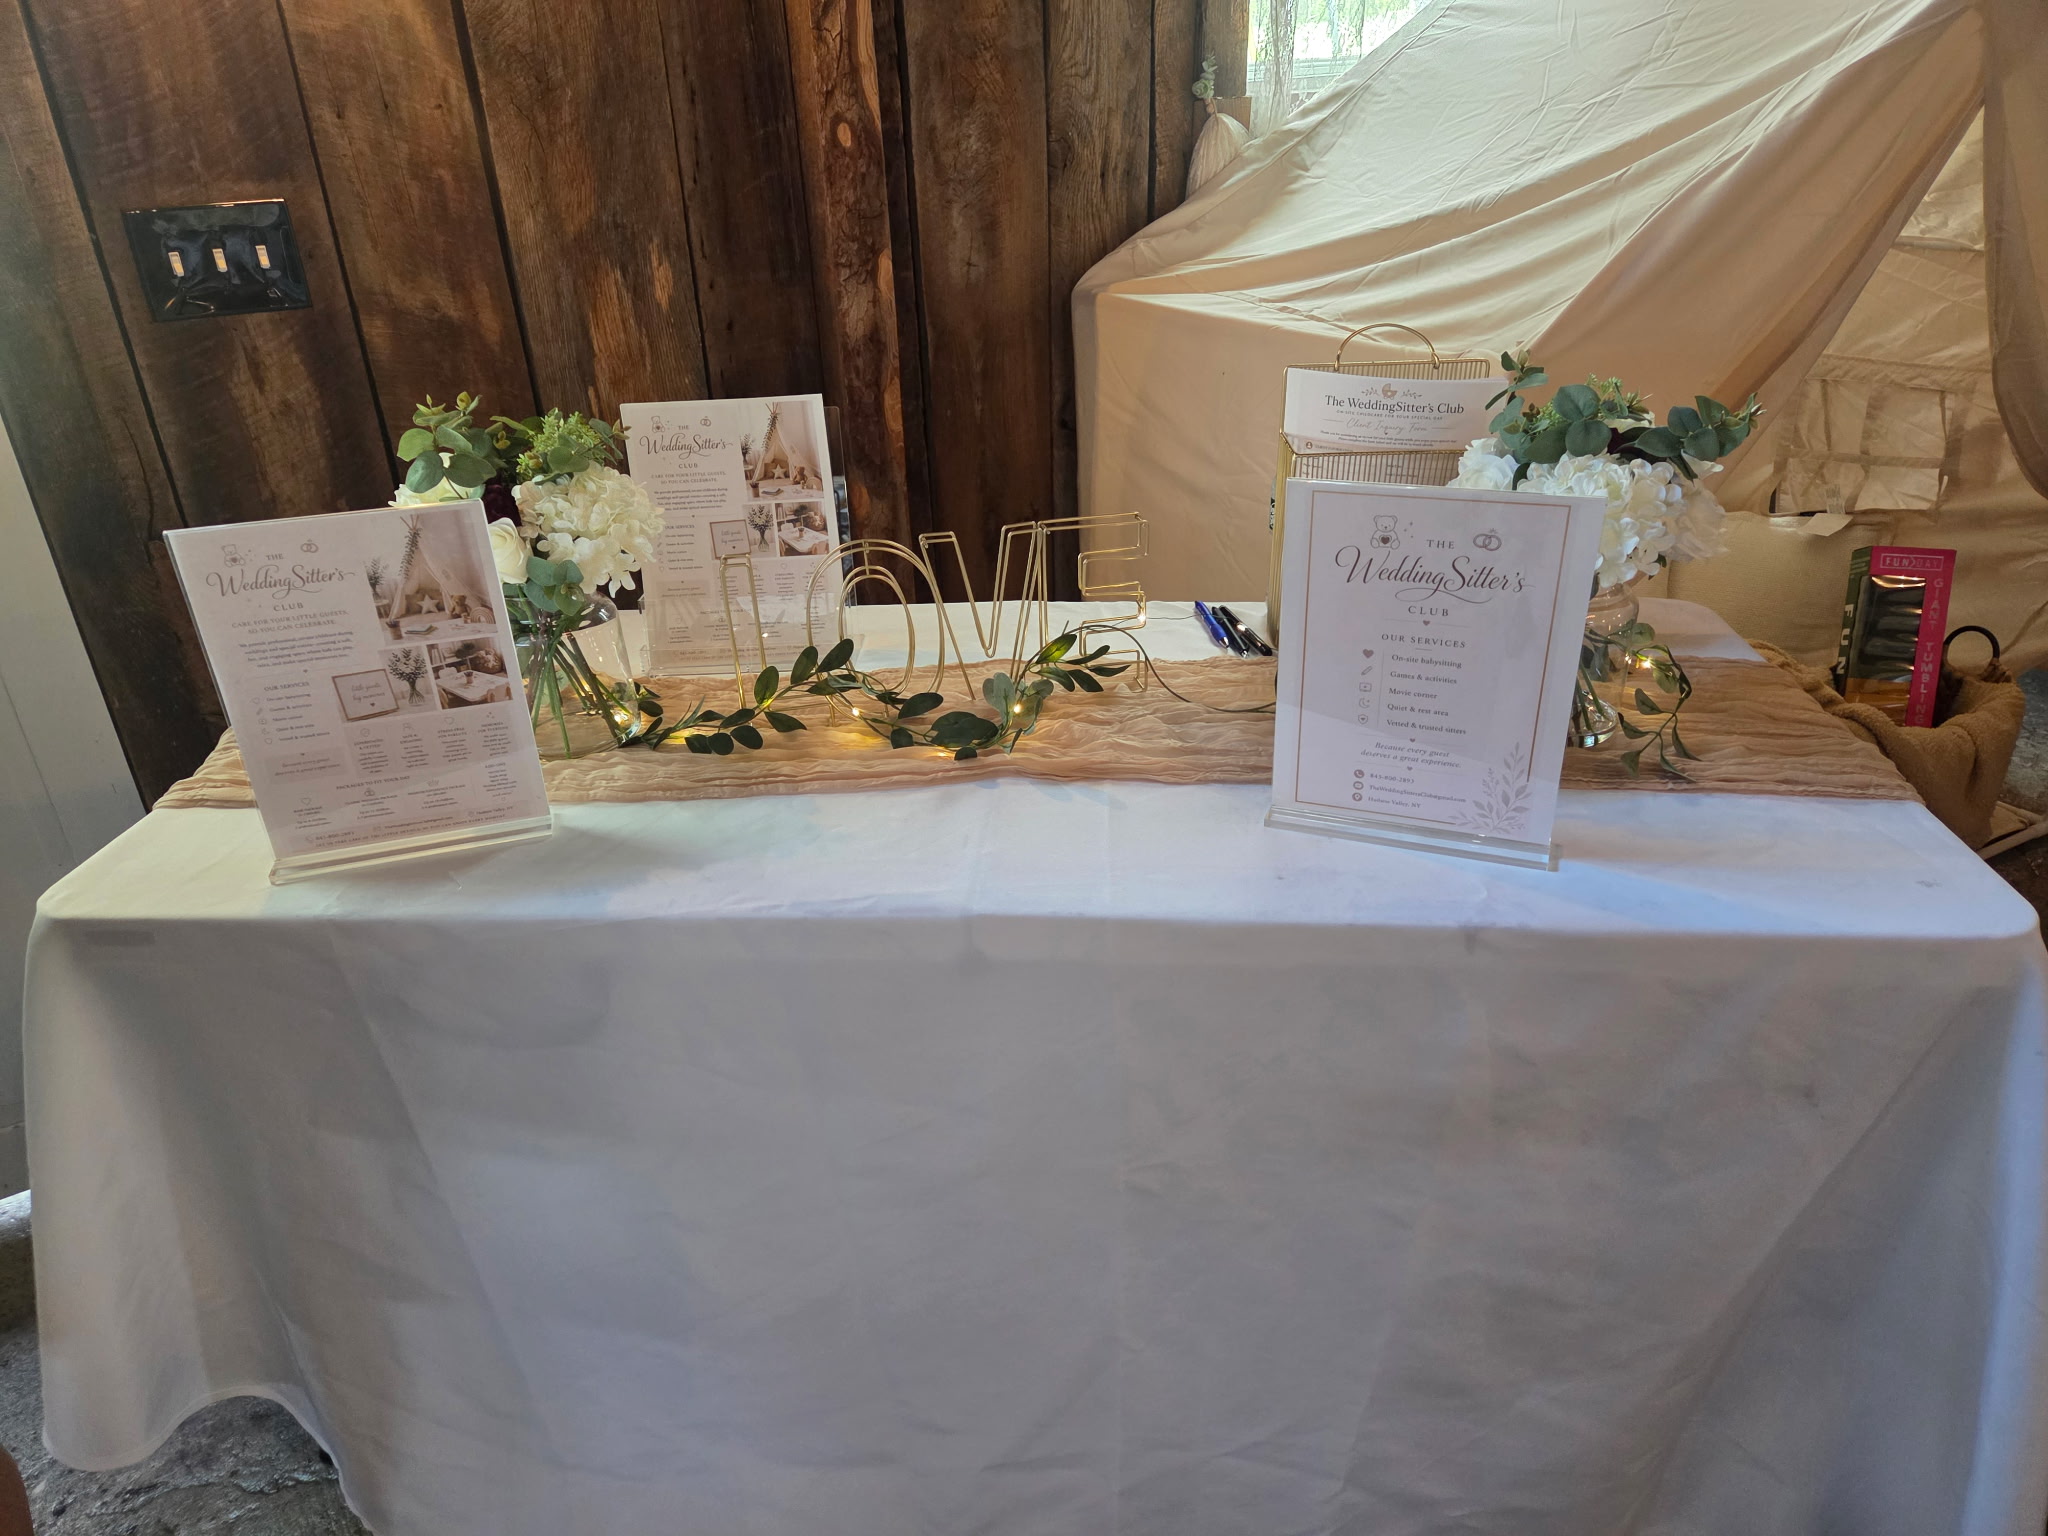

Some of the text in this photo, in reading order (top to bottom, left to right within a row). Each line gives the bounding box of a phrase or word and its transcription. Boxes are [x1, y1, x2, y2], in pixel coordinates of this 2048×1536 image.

[1325, 394, 1465, 415] The WeddingSitter's Club
[1346, 418, 1428, 434] Client Inquiry Form
[639, 432, 734, 460] WeddingSitter's
[1426, 538, 1456, 550] THE
[266, 553, 284, 561] THE
[1885, 556, 1910, 567] FUN
[205, 564, 355, 600] WeddingSitter's
[1335, 545, 1536, 605] WeddingSitter's
[273, 602, 304, 612] CLUB
[1407, 605, 1450, 618] CLUB
[1930, 578, 1944, 630] GIANT
[253, 618, 268, 626] FOR
[269, 616, 290, 624] YOUR
[720, 511, 1149, 727] LOVE
[259, 626, 276, 634] YOU
[276, 624, 294, 632] CAN
[1381, 633, 1467, 649] OUR SERVICES
[1391, 654, 1462, 670] On-site babysitting
[1390, 670, 1415, 680] Games
[1424, 675, 1458, 685] activities
[1914, 642, 1934, 724] TUMBLING
[1388, 688, 1438, 700] Movie corner
[1387, 703, 1408, 712] Quiet
[1418, 707, 1431, 715] rest
[1433, 709, 1449, 717] area
[1386, 719, 1409, 729] Vetted
[1419, 723, 1444, 733] trusted
[1445, 727, 1467, 736] sitters
[1375, 742, 1450, 758] Because every guest
[1360, 750, 1391, 760] deserves
[1399, 755, 1419, 764] great
[1421, 757, 1462, 769] experience.
